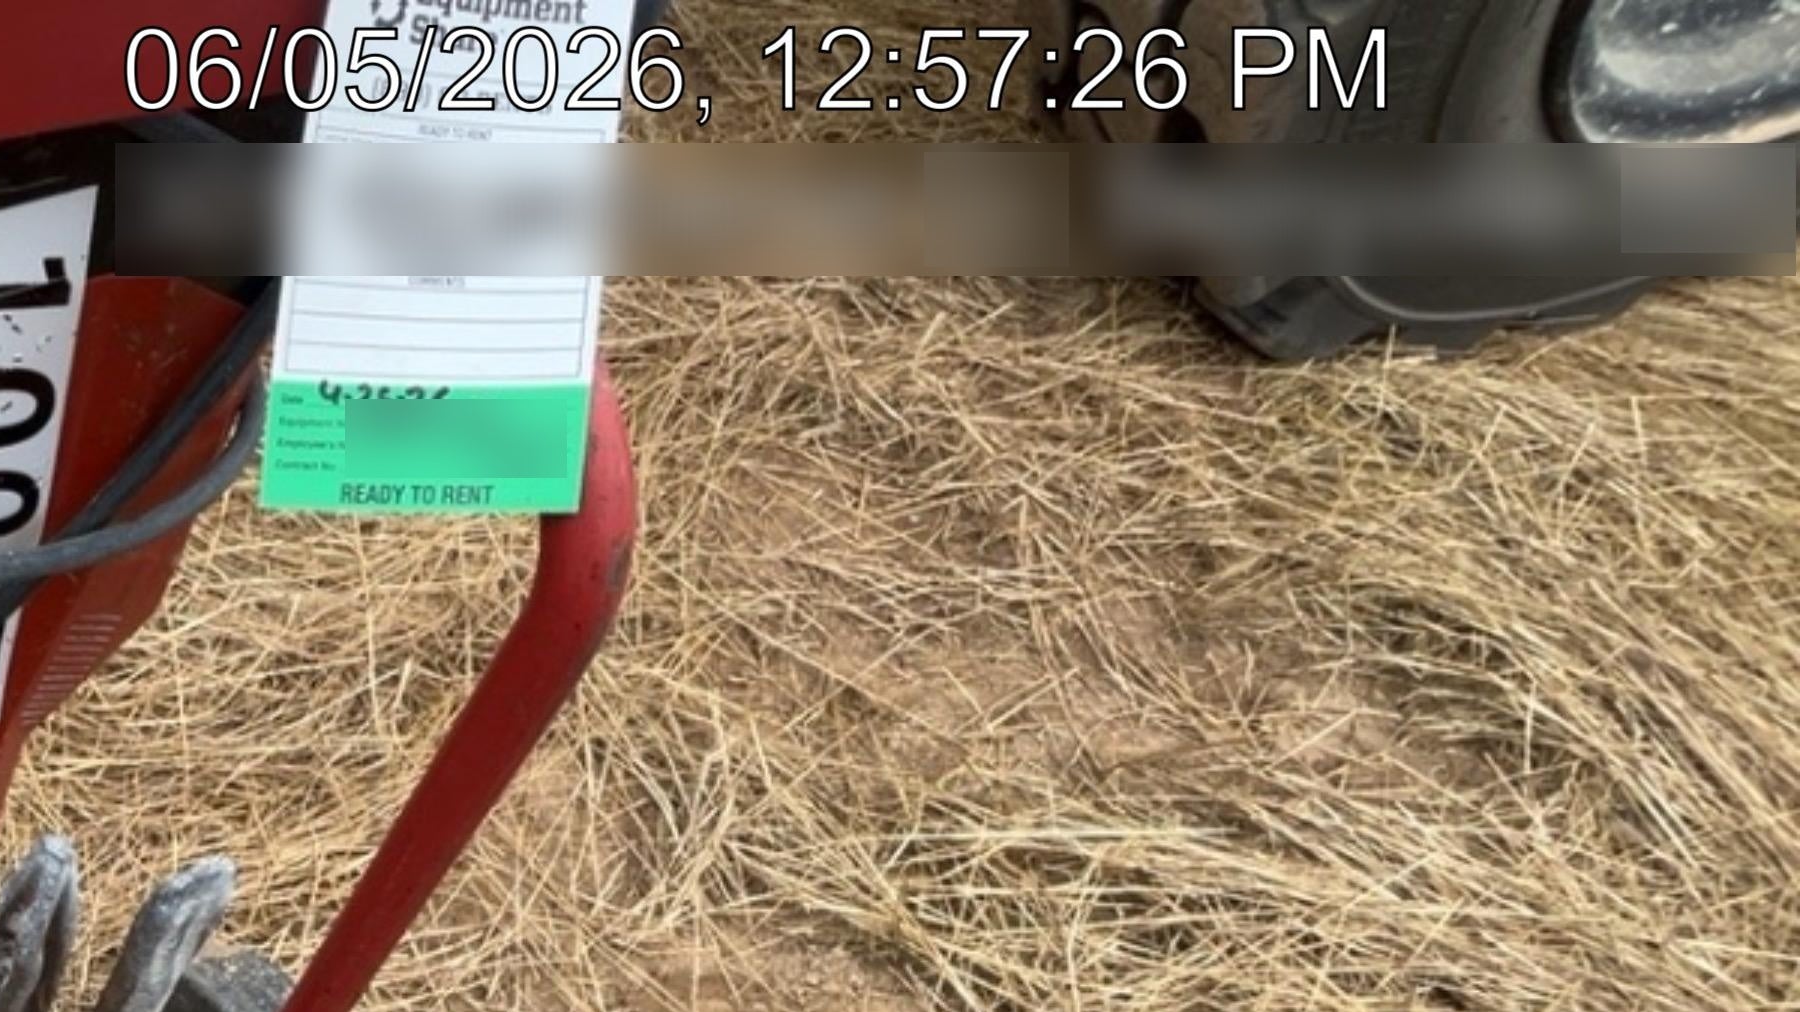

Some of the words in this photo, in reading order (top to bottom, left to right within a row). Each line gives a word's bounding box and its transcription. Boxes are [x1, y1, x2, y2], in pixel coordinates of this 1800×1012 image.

[414, 0, 588, 24] quipment
[408, 14, 498, 52] Shr
[339, 481, 406, 505] READY
[410, 485, 437, 505] TO
[441, 485, 495, 506] RENT
